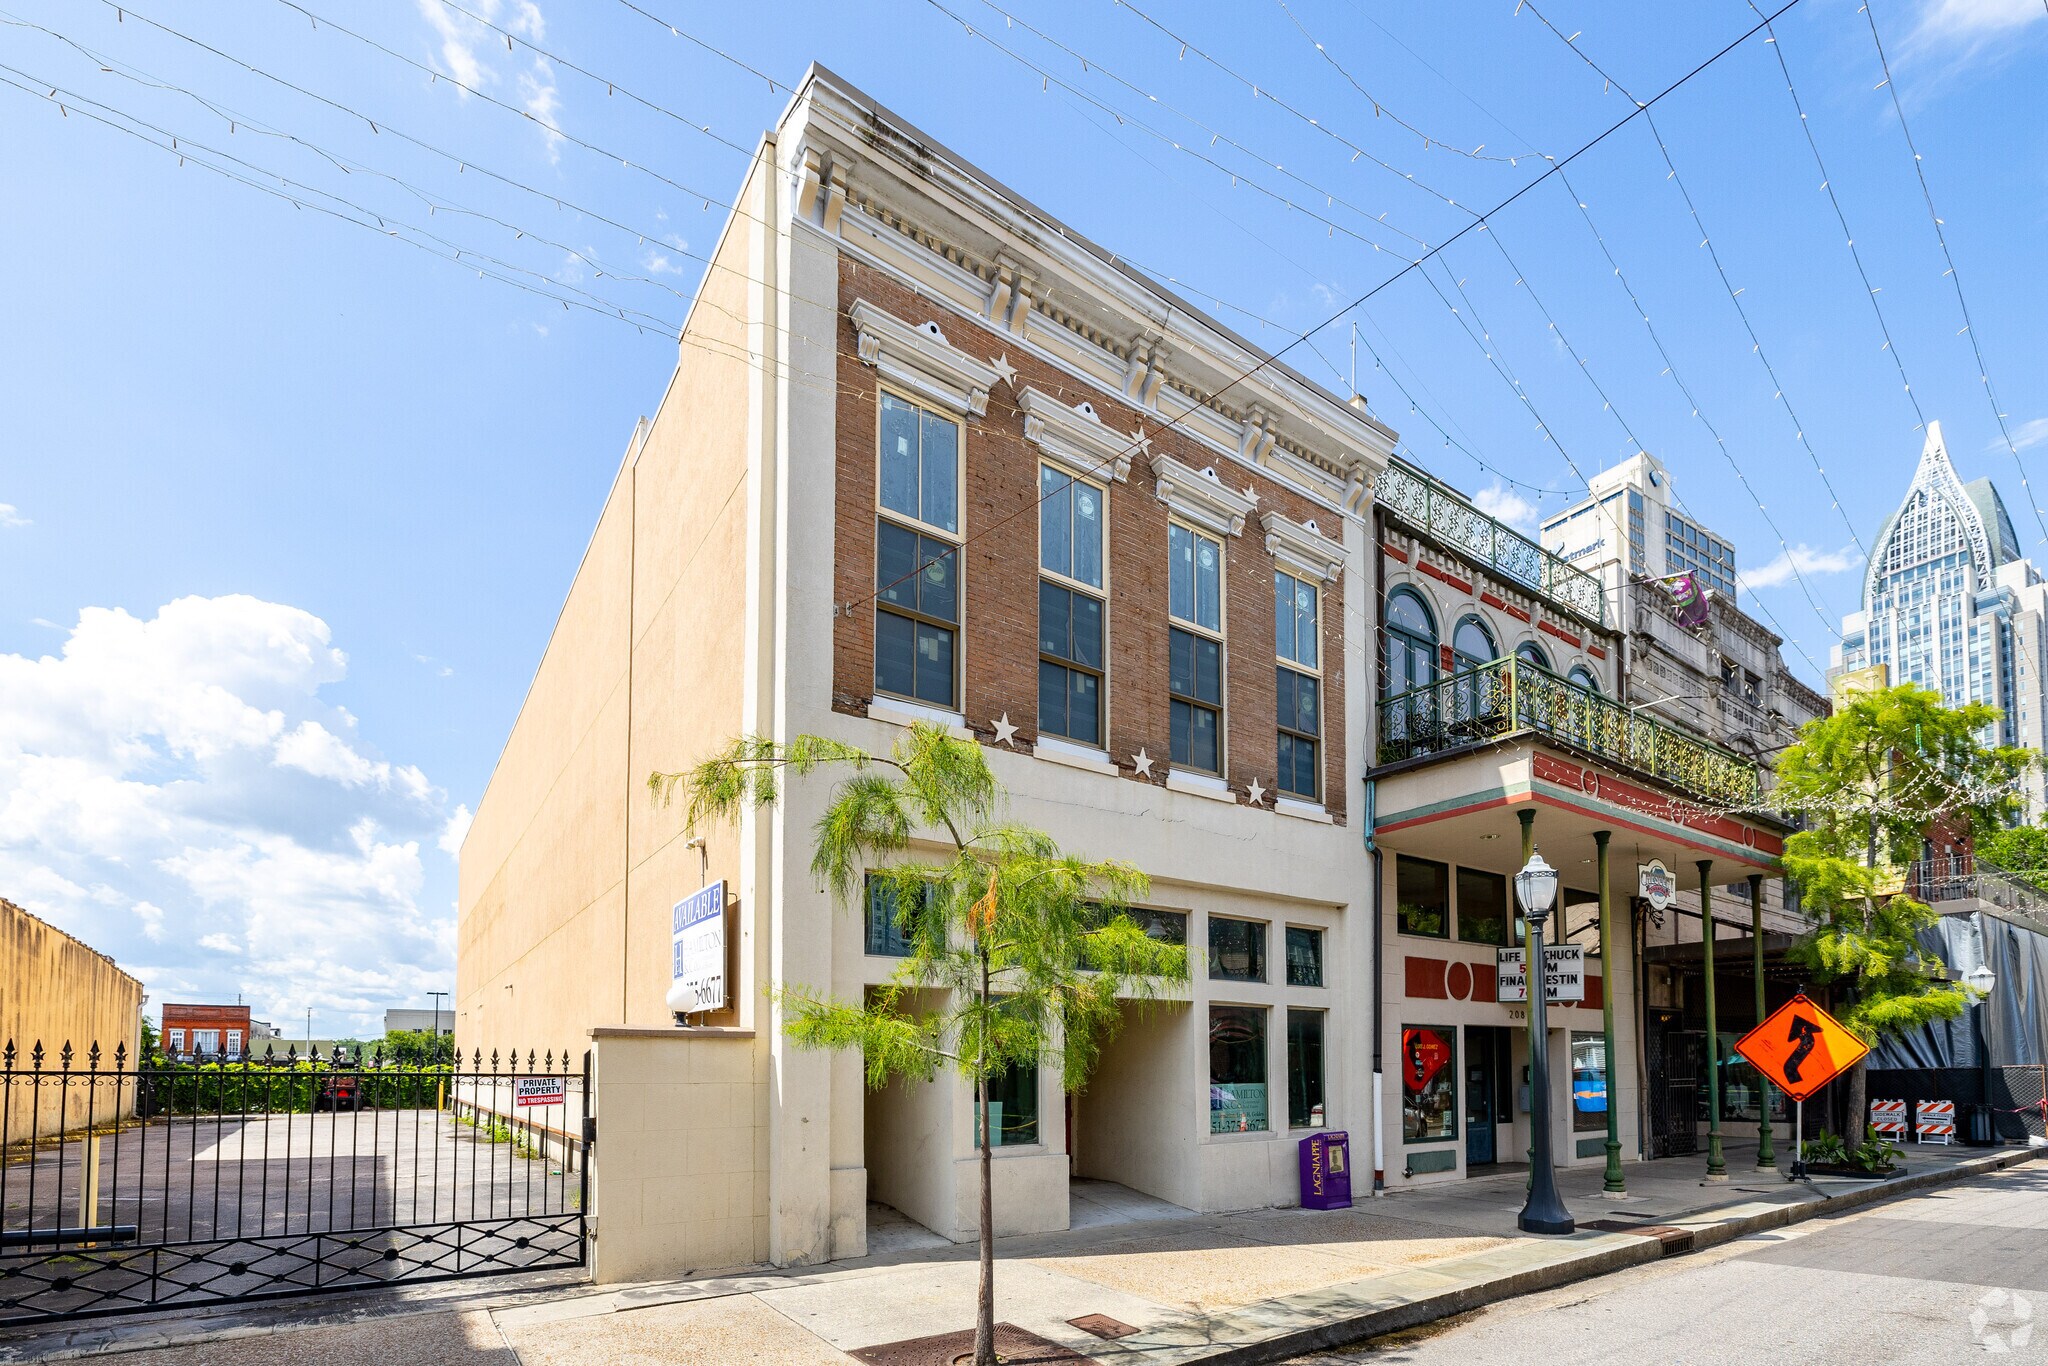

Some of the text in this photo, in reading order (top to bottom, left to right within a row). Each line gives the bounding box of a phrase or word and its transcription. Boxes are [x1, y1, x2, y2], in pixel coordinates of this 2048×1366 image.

[674, 887, 720, 931] AVAILABLE
[1500, 949, 1579, 962] LIFE CHUCK
[1545, 963, 1558, 973] M
[1500, 974, 1578, 986] FINA ESTIN
[686, 976, 721, 1006] 5-6677
[1518, 987, 1558, 998] 7 M
[1509, 1010, 1525, 1019] 208
[523, 1078, 556, 1087] PRIVATE
[519, 1086, 560, 1095] PROPERTY
[527, 1096, 563, 1104] TRESPASSING
[1312, 1140, 1322, 1195] LAGNIAPPE
